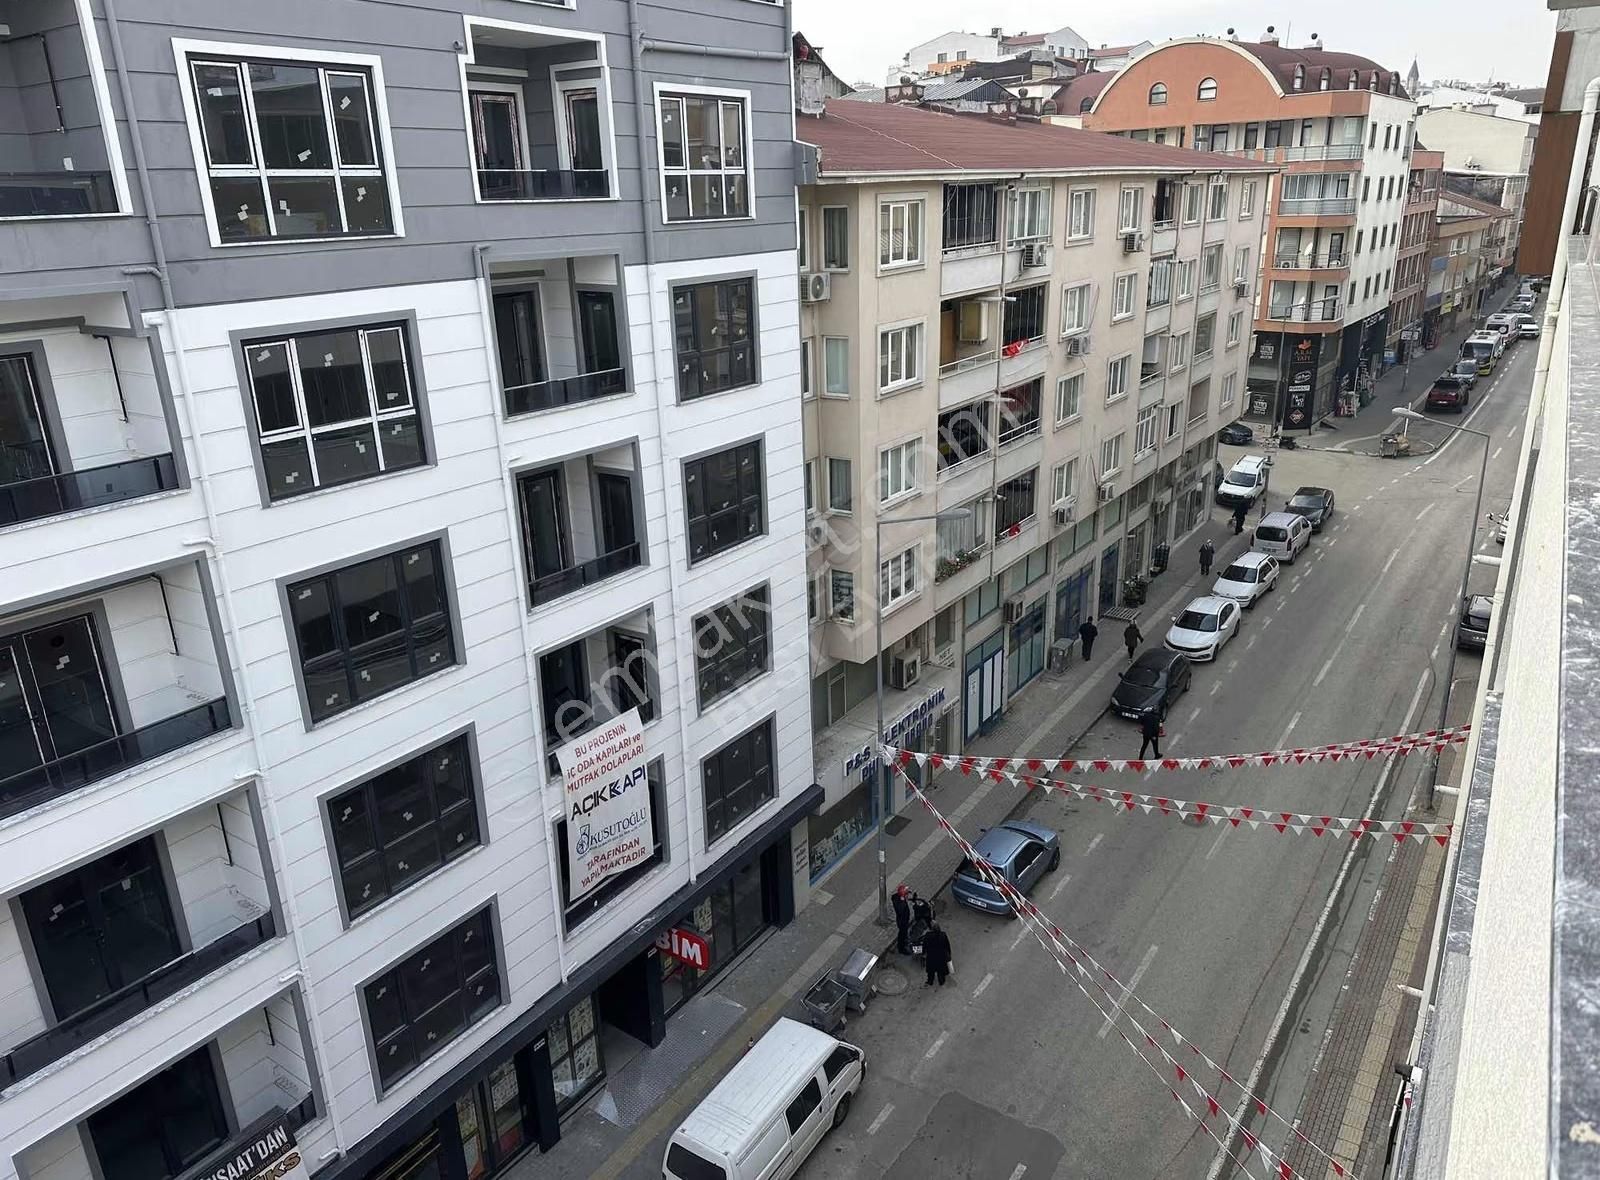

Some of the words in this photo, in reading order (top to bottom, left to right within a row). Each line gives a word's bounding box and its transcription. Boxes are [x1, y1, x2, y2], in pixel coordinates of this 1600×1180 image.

[880, 686, 945, 746] LEKTRONİK
[567, 767, 576, 779] İÇ
[577, 757, 595, 774] ODA
[595, 736, 631, 764] KAPILARI
[632, 733, 641, 744] ve
[574, 745, 587, 758] BU
[588, 723, 627, 751] PROJENİN
[567, 769, 600, 794] MUTFAK
[600, 743, 644, 776] DOLAPLARI
[587, 837, 640, 870] TARAFINDAN
